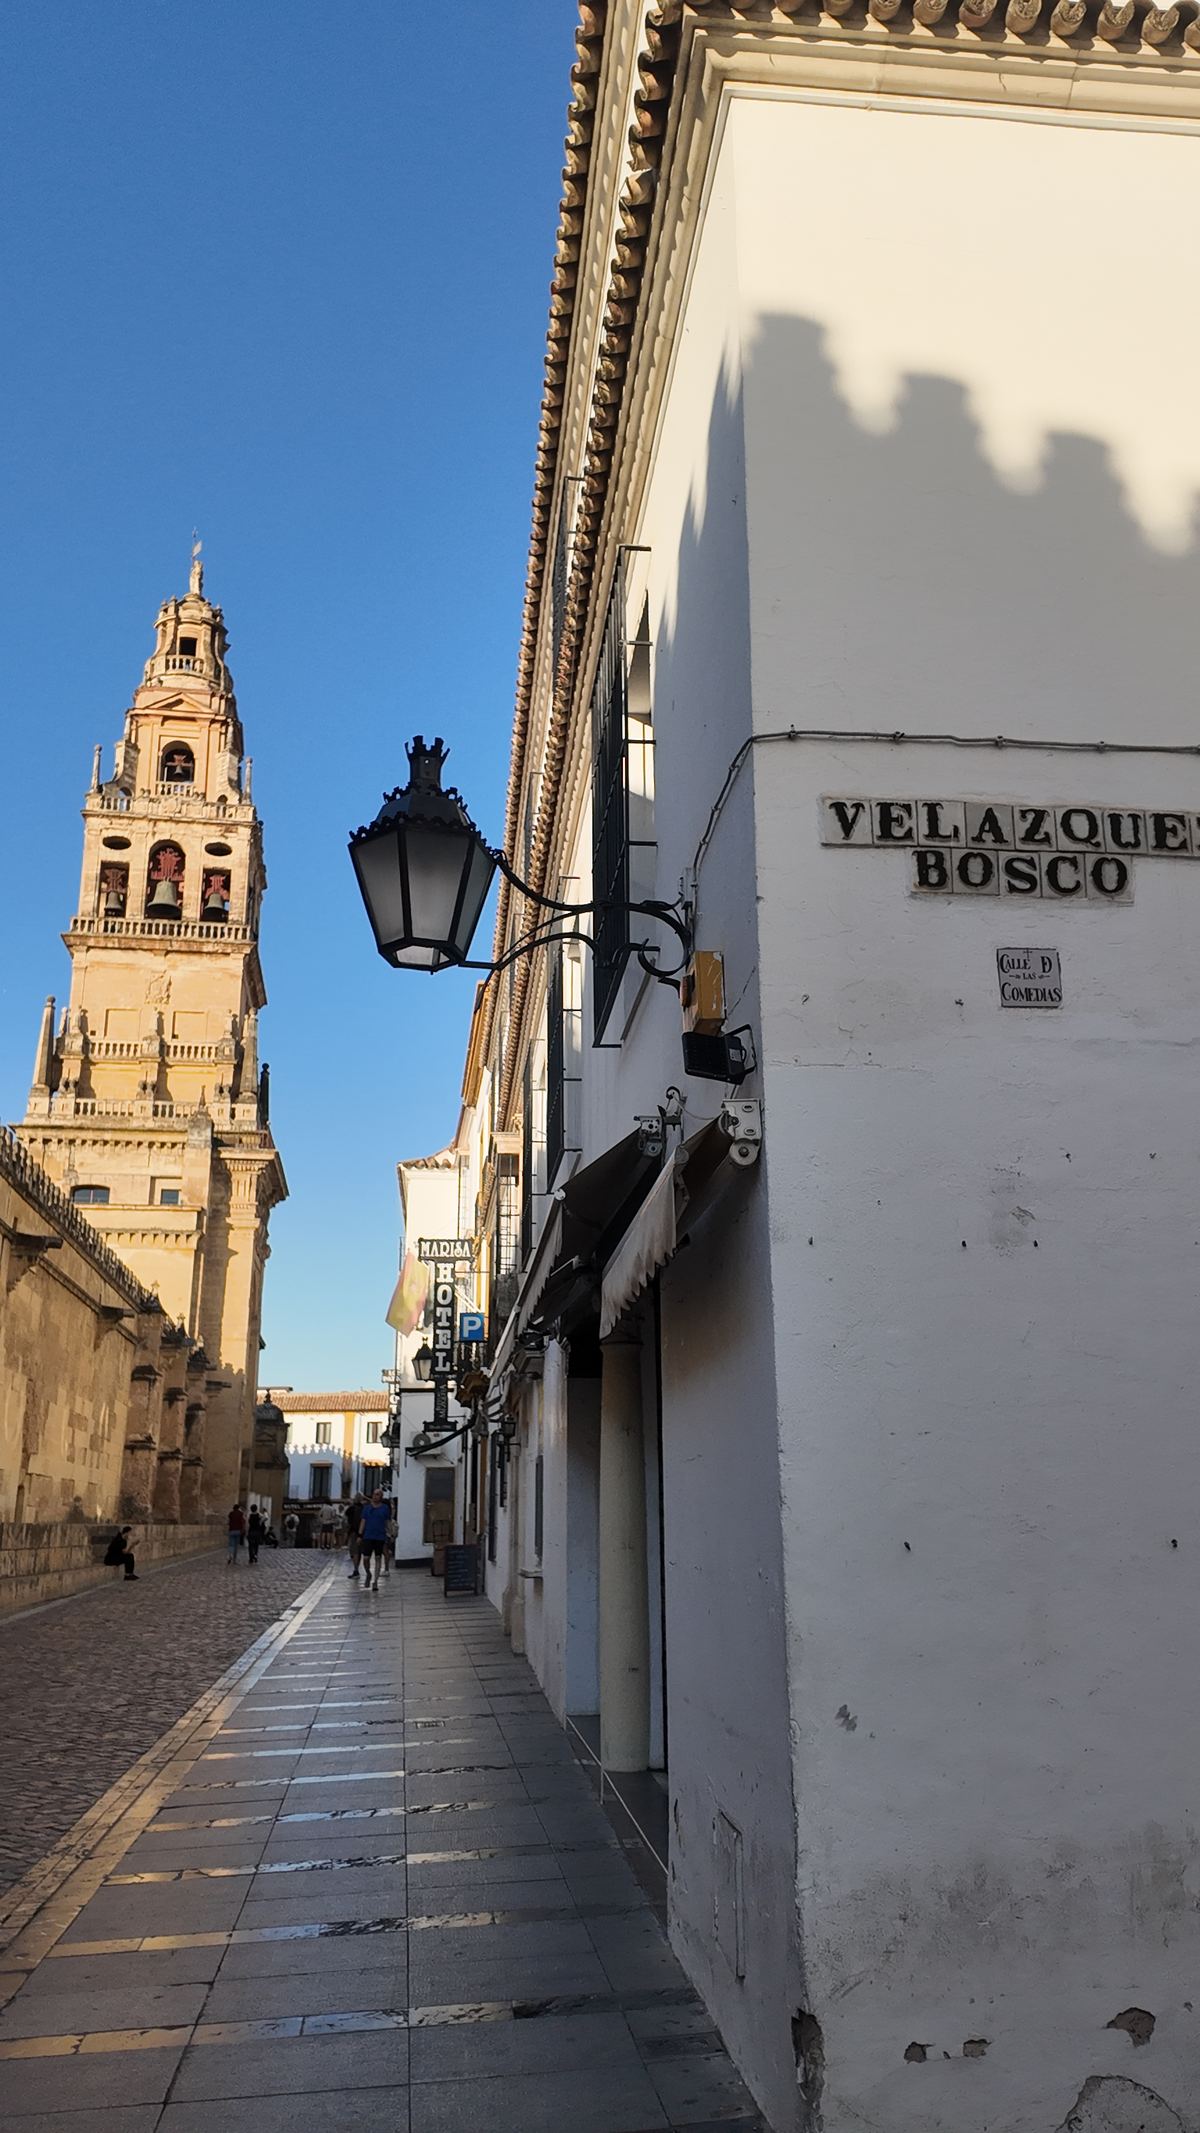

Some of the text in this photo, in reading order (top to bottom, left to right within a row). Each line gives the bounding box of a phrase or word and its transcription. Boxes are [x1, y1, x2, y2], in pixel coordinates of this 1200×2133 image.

[829, 801, 1200, 850] VELAZQUE
[912, 850, 1128, 894] BOSCO
[1000, 954, 1031, 973] CALLE
[1002, 982, 1062, 1002] COMEDIAS
[420, 1241, 471, 1257] MARISA
[435, 1263, 454, 1372] HOTEL
[463, 1316, 482, 1338] P
